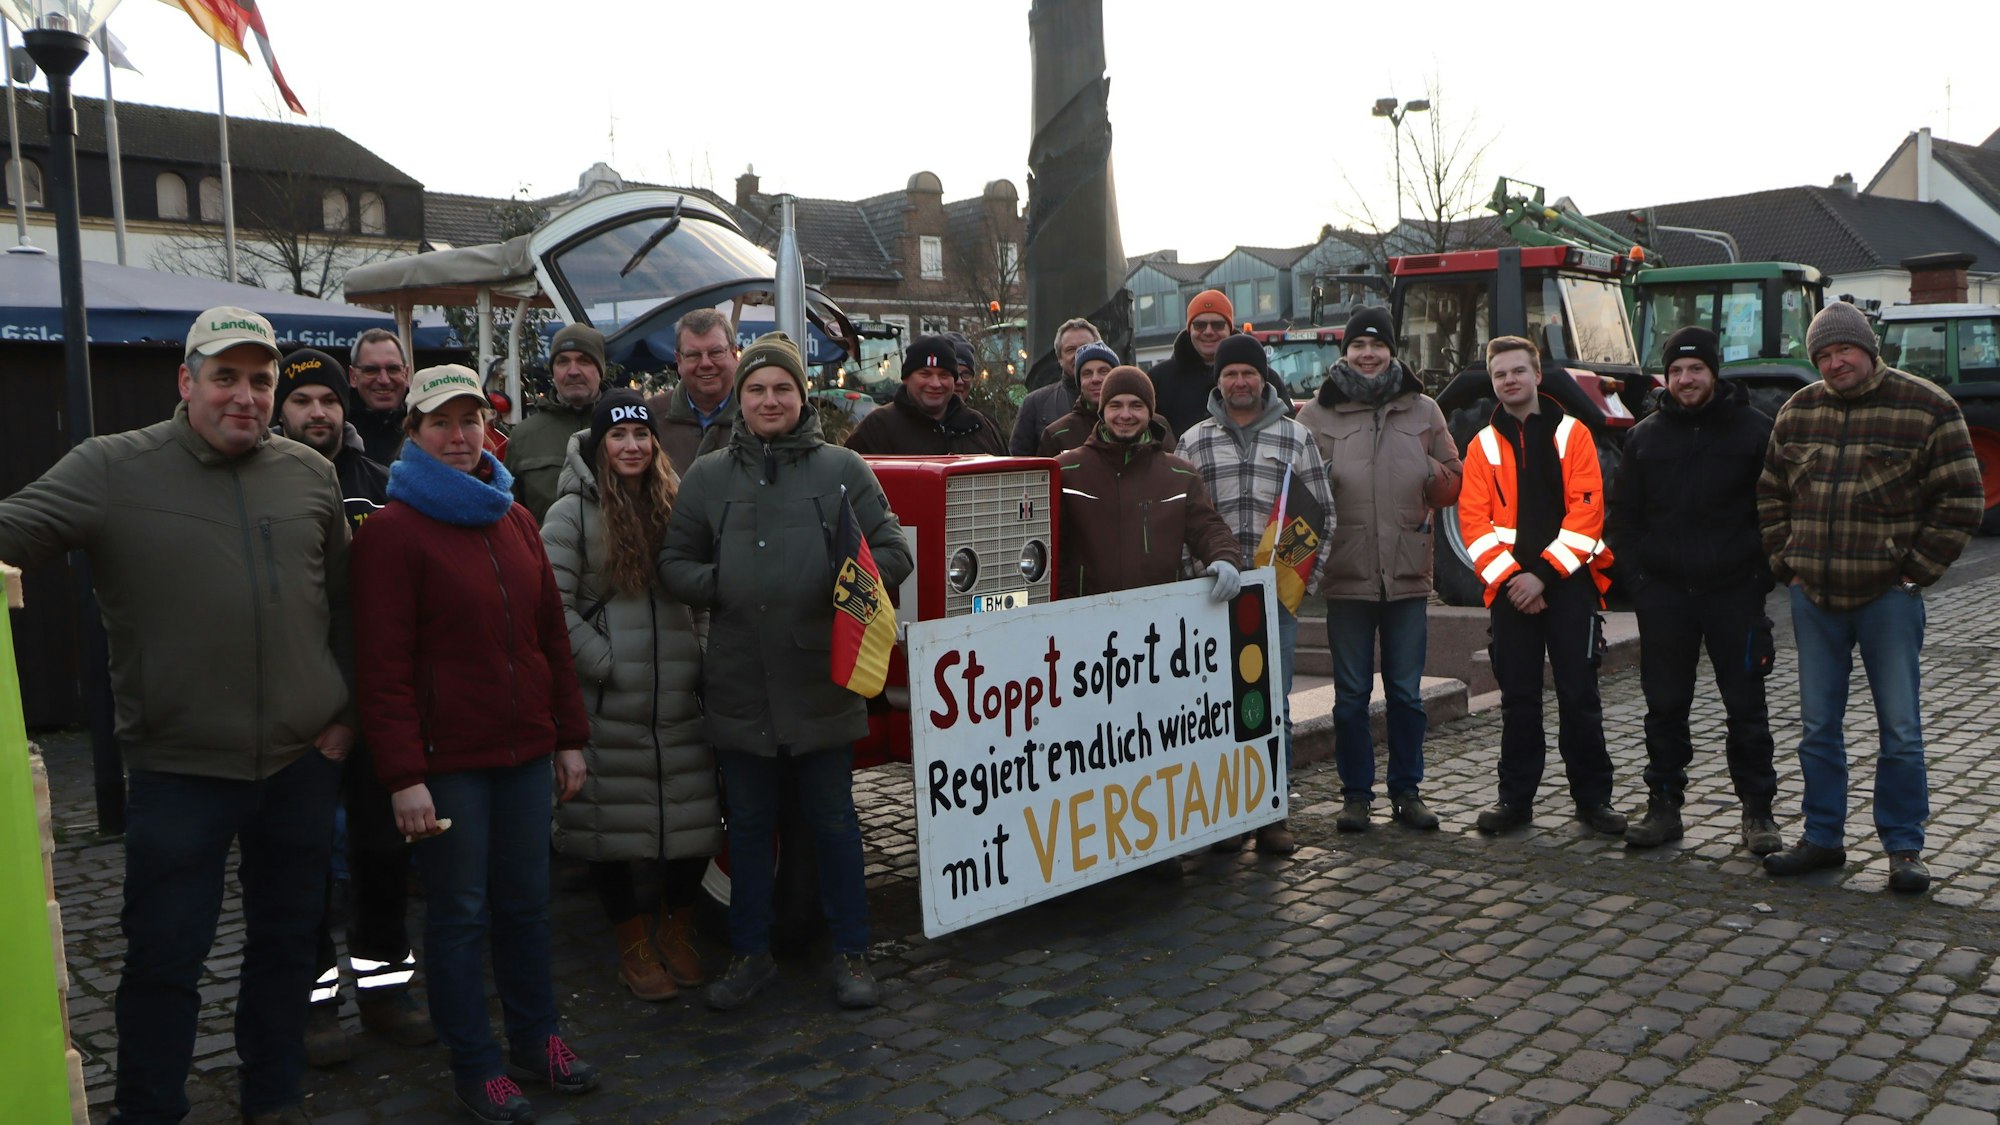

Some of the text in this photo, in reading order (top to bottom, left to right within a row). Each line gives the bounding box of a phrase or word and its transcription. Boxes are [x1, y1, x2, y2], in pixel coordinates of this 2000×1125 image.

[284, 357, 322, 379] Vredo
[610, 405, 649, 423] DKS
[986, 596, 1003, 612] BM
[930, 617, 1218, 738] Stoppt sofort die
[928, 692, 1232, 818] Regiert endlich wieder
[942, 735, 1280, 900] mit VERSTAND!
